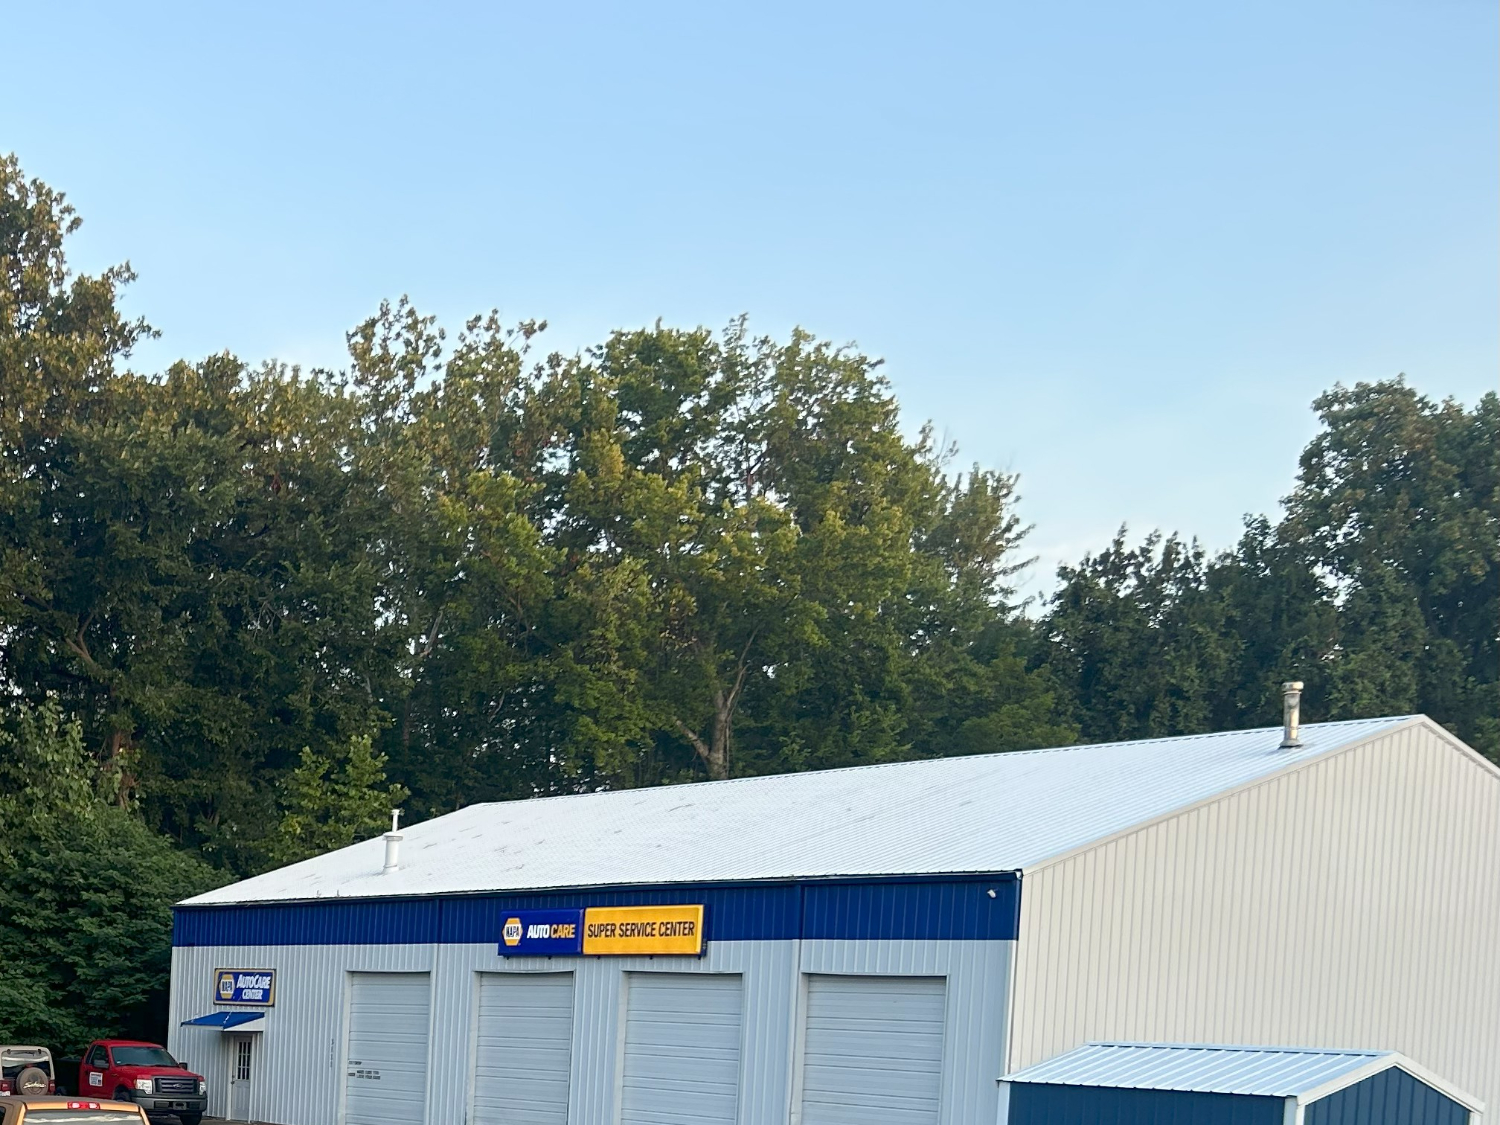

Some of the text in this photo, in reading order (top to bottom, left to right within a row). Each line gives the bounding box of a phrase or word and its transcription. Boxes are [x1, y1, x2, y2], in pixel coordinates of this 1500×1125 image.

[587, 921, 695, 939] SUPER SERVICE CENTER
[236, 974, 271, 989] AUTOCARE
[242, 989, 263, 1000] CENTER
